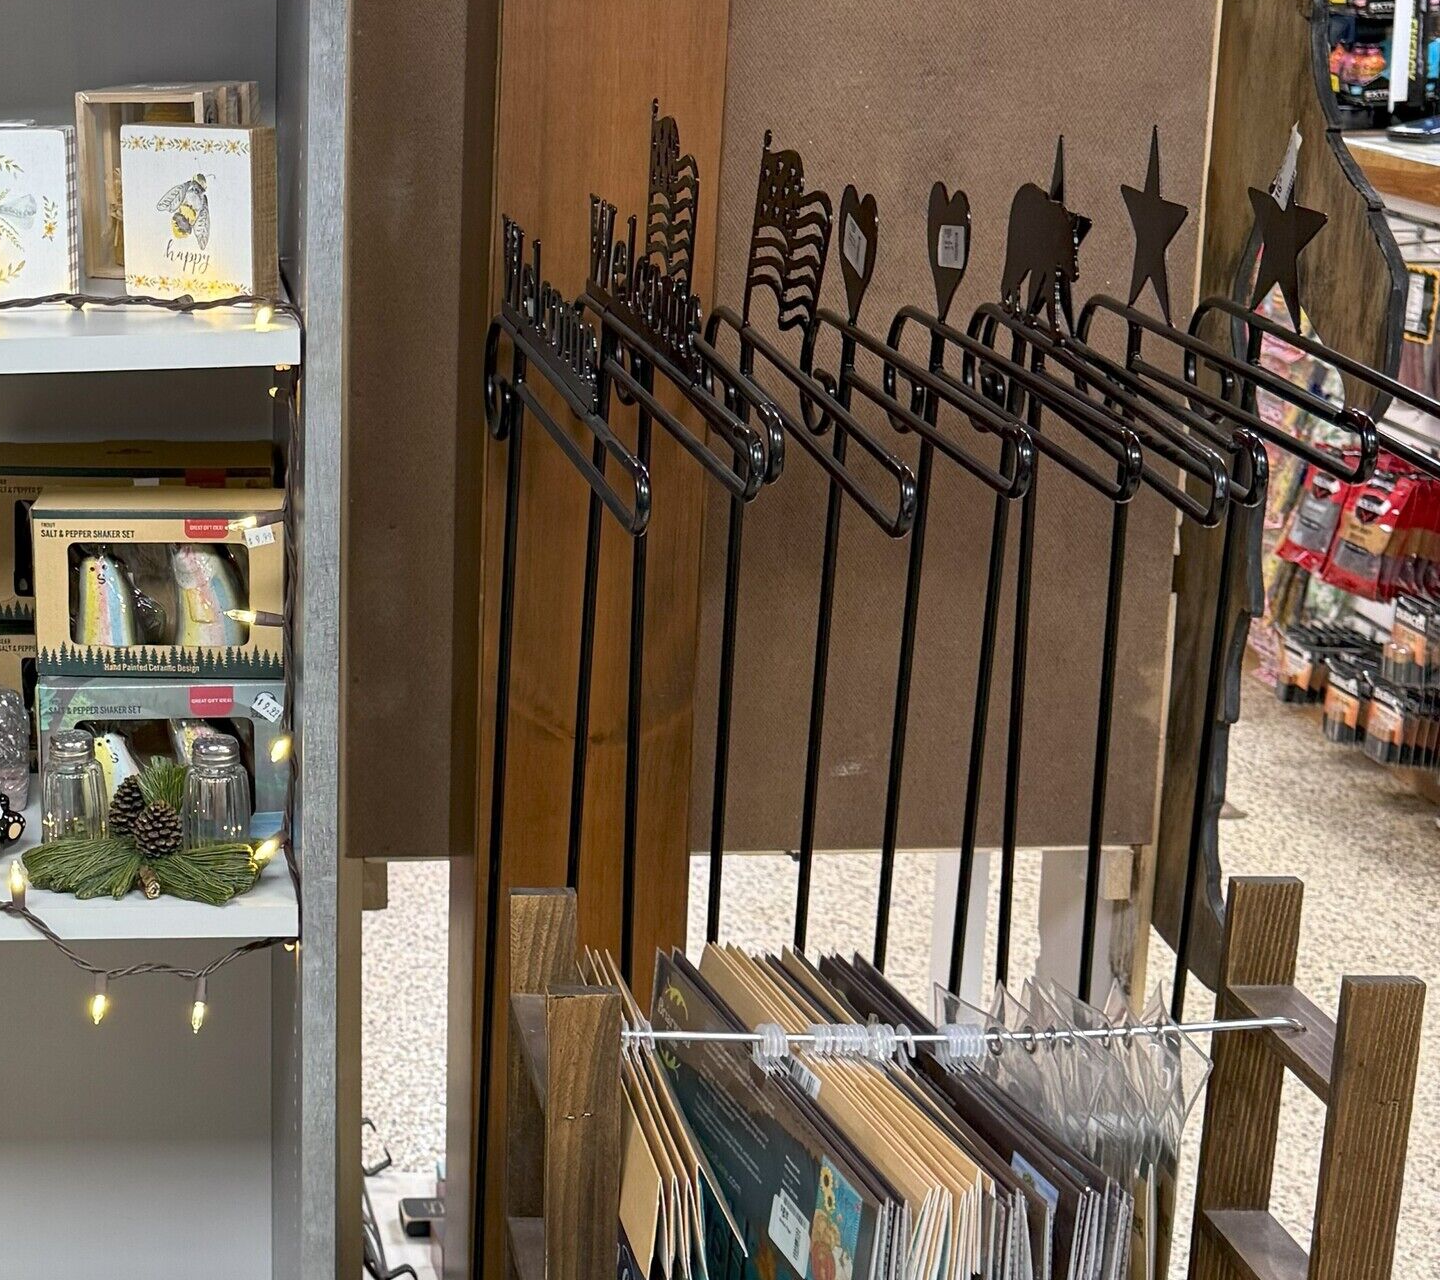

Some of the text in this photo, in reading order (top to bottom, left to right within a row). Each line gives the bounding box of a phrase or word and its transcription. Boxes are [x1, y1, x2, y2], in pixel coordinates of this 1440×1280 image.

[166, 238, 210, 275] happy
[41, 529, 135, 539] SALT & PEPPER SHAKER SET
[97, 573, 106, 584] S
[104, 663, 200, 673] Hand Painted Ceramic Design
[49, 705, 141, 715] SALT & PEPPER SHAKER SET
[110, 752, 119, 764] S
